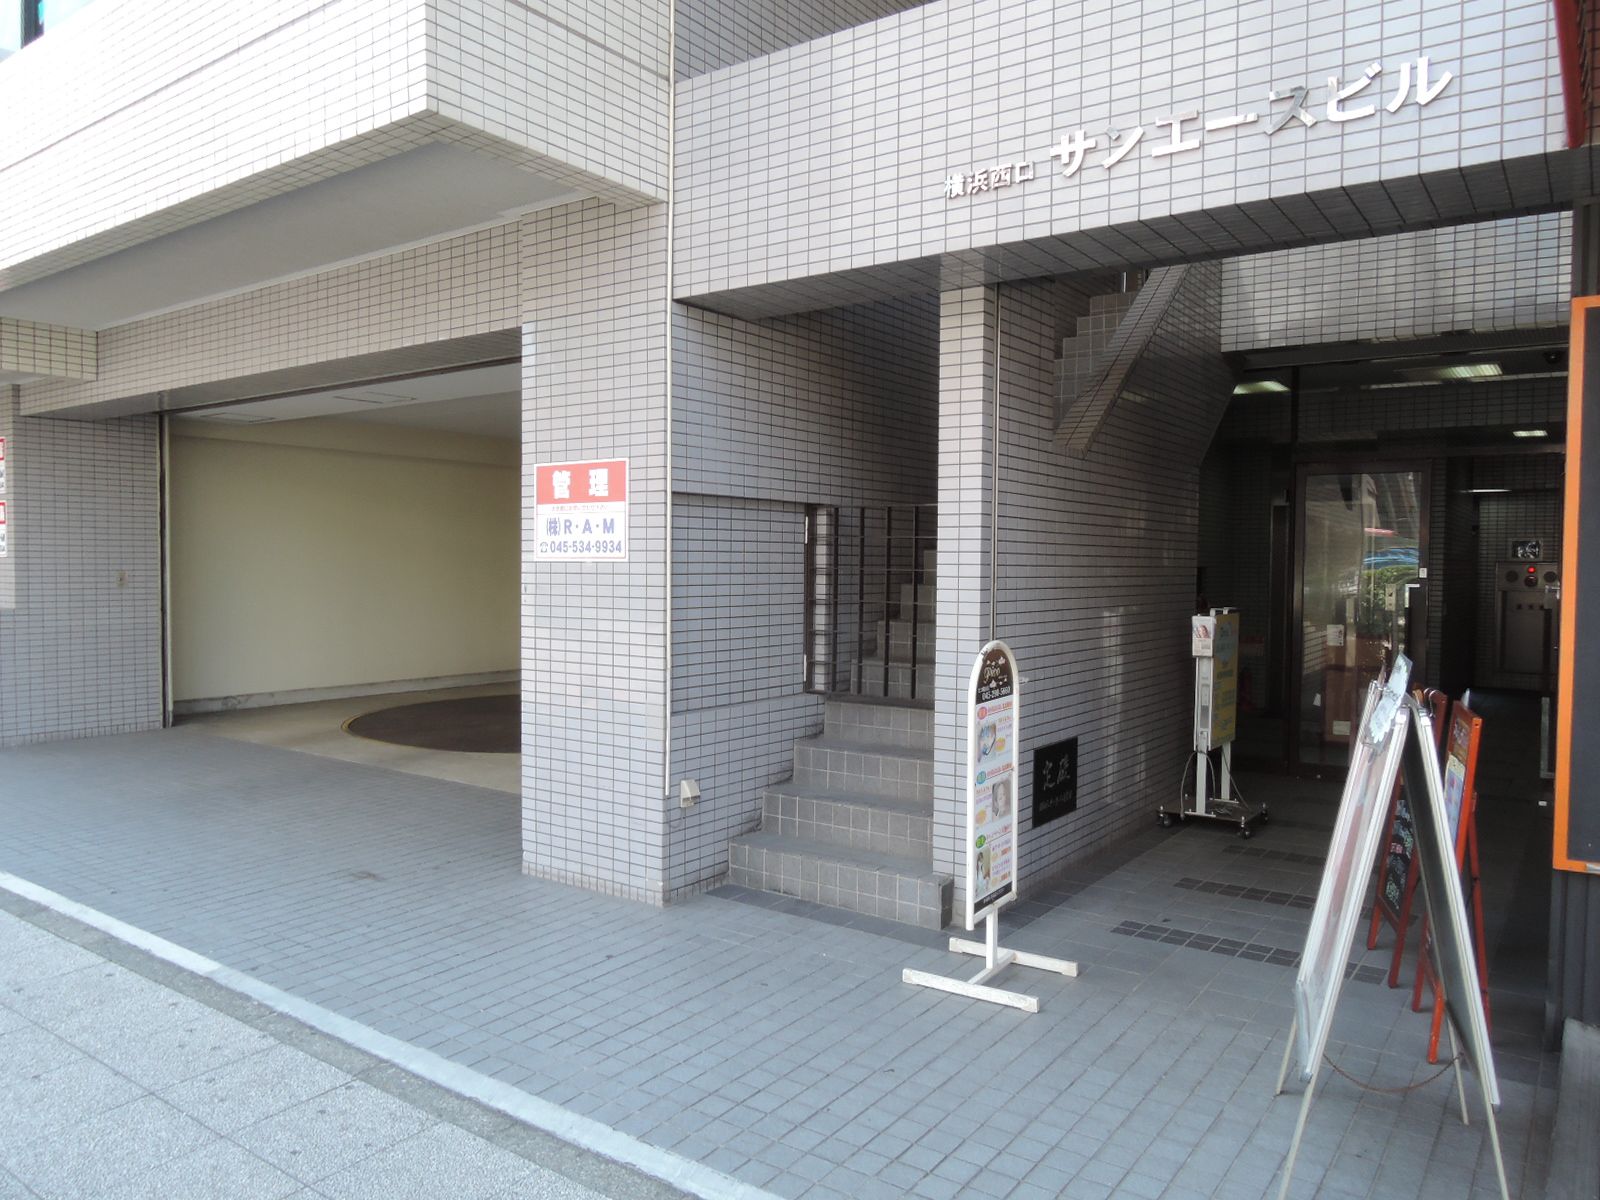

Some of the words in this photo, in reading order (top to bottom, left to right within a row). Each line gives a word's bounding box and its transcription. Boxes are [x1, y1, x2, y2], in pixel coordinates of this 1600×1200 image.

[944, 161, 1034, 199] 横浜西口
[1050, 56, 1453, 177] サンエースビル
